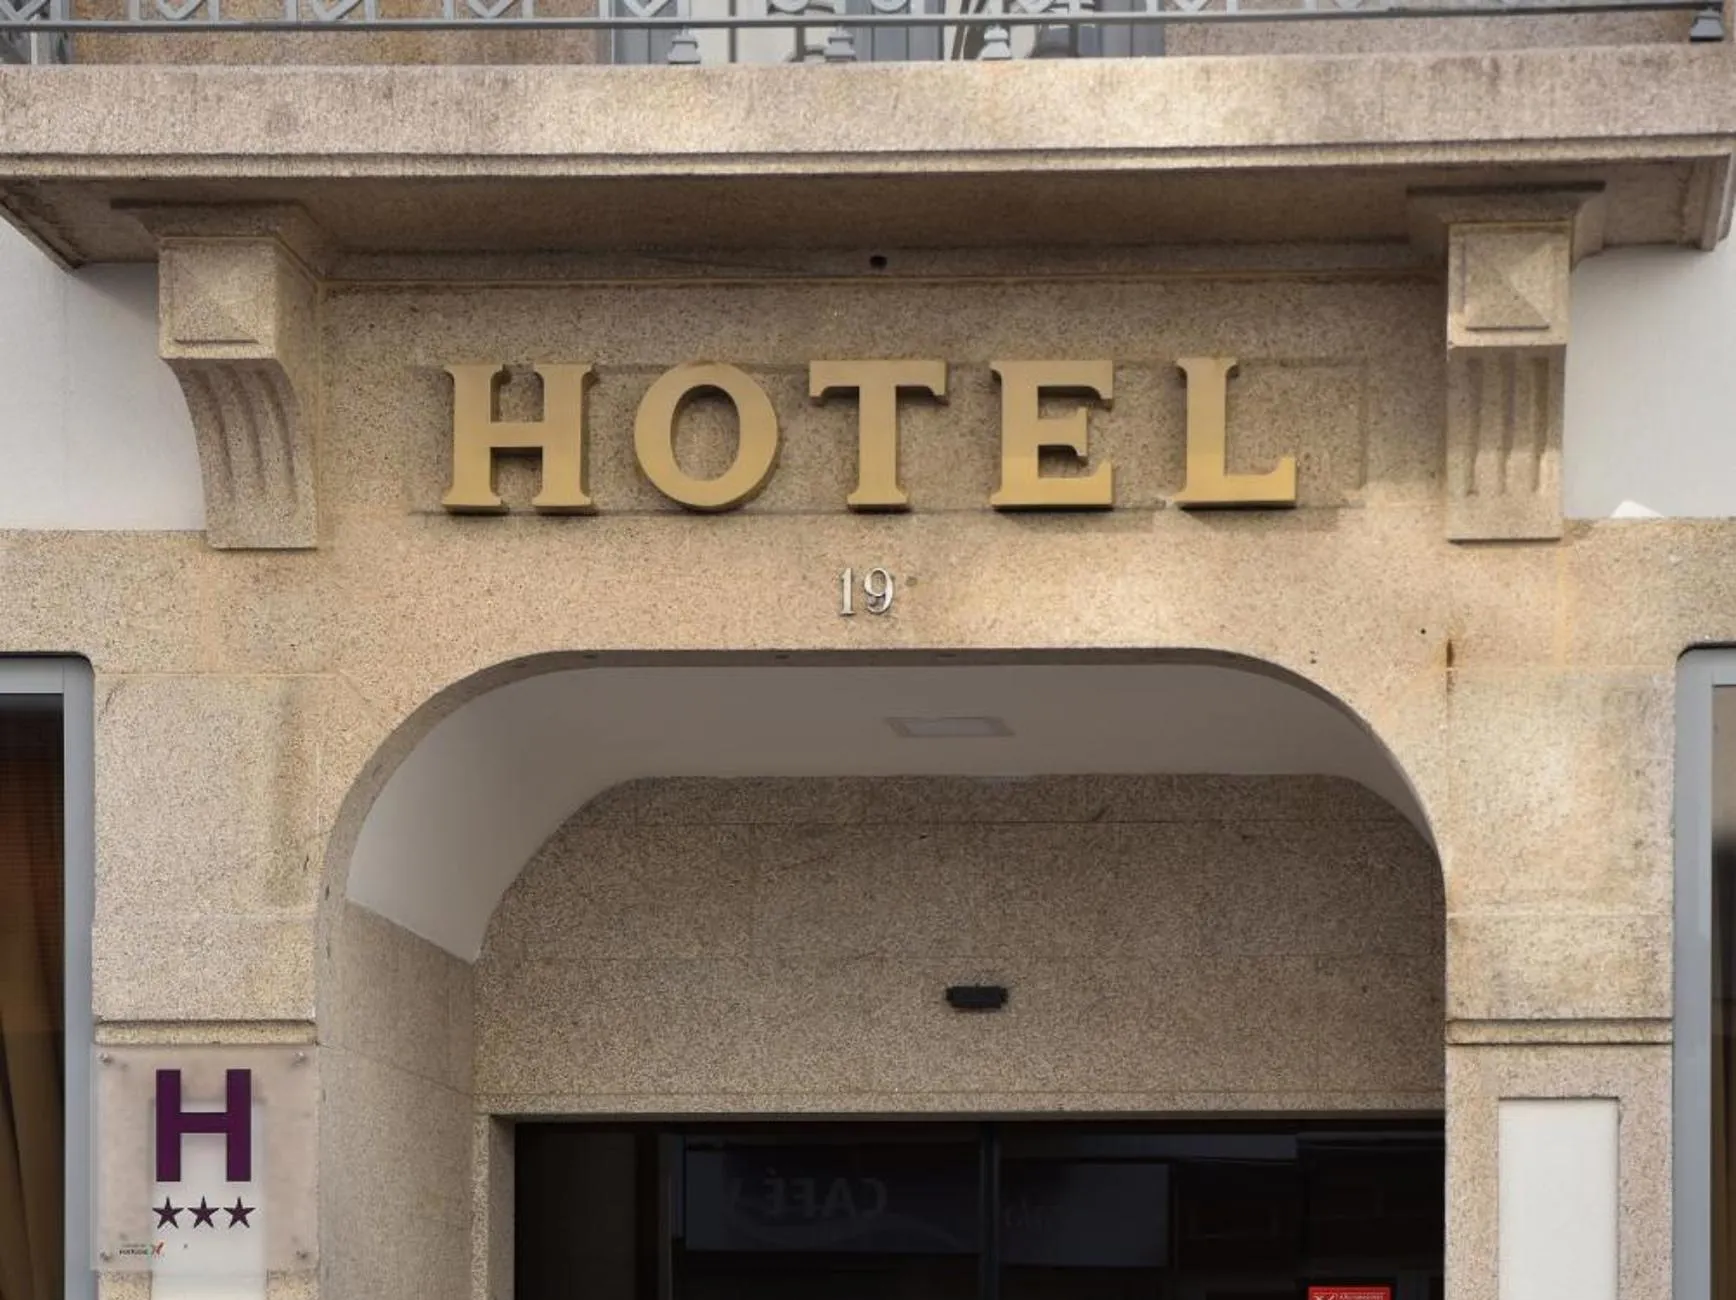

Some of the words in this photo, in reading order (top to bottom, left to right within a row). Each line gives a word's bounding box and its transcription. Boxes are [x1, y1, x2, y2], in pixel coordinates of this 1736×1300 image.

[441, 357, 1299, 513] HOTEL
[838, 566, 895, 618] 19
[156, 1068, 252, 1182] H
